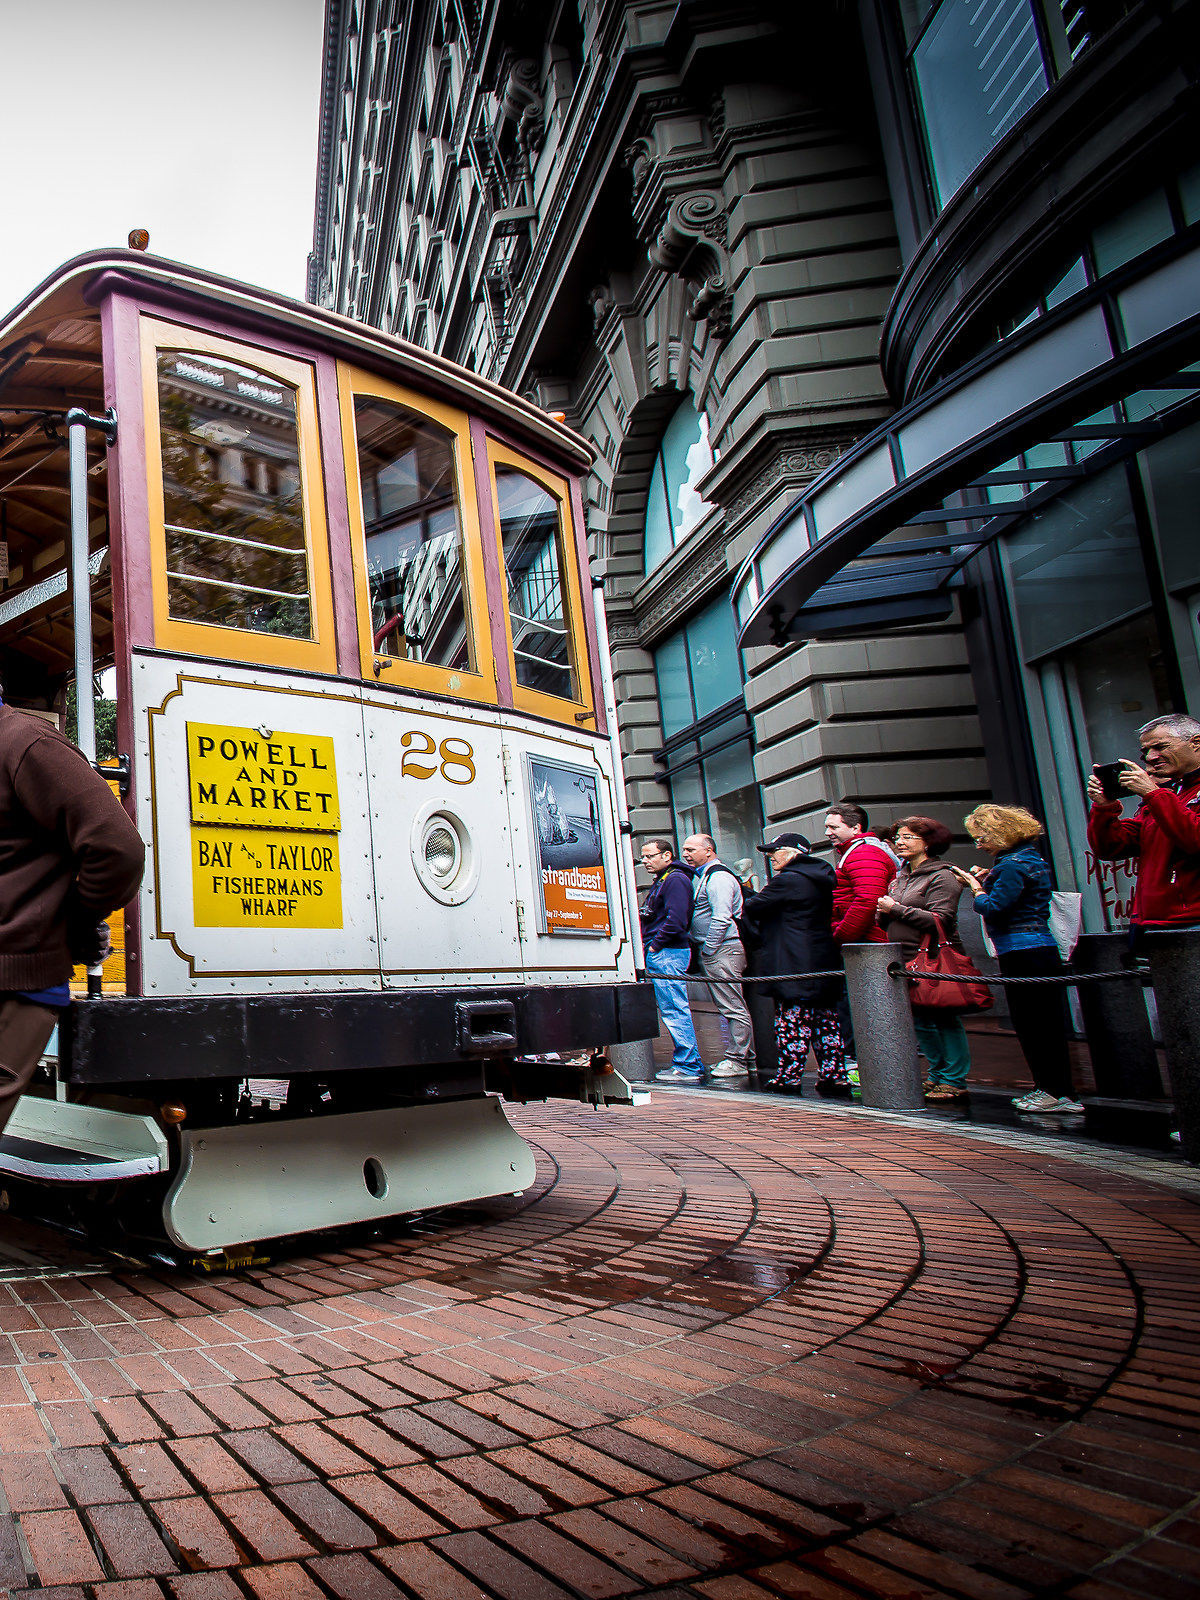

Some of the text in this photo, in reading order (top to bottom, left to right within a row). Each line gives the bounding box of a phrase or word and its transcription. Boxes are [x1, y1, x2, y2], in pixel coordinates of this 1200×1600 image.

[197, 735, 328, 770] POWELL
[400, 730, 477, 785] 28
[235, 766, 299, 787] AND
[197, 782, 333, 814] MARKET
[198, 840, 334, 872] BAY AND TAYLOR
[211, 875, 324, 896] FISHERMANS
[541, 865, 602, 890] strandbeest
[240, 898, 298, 916] WHARF
